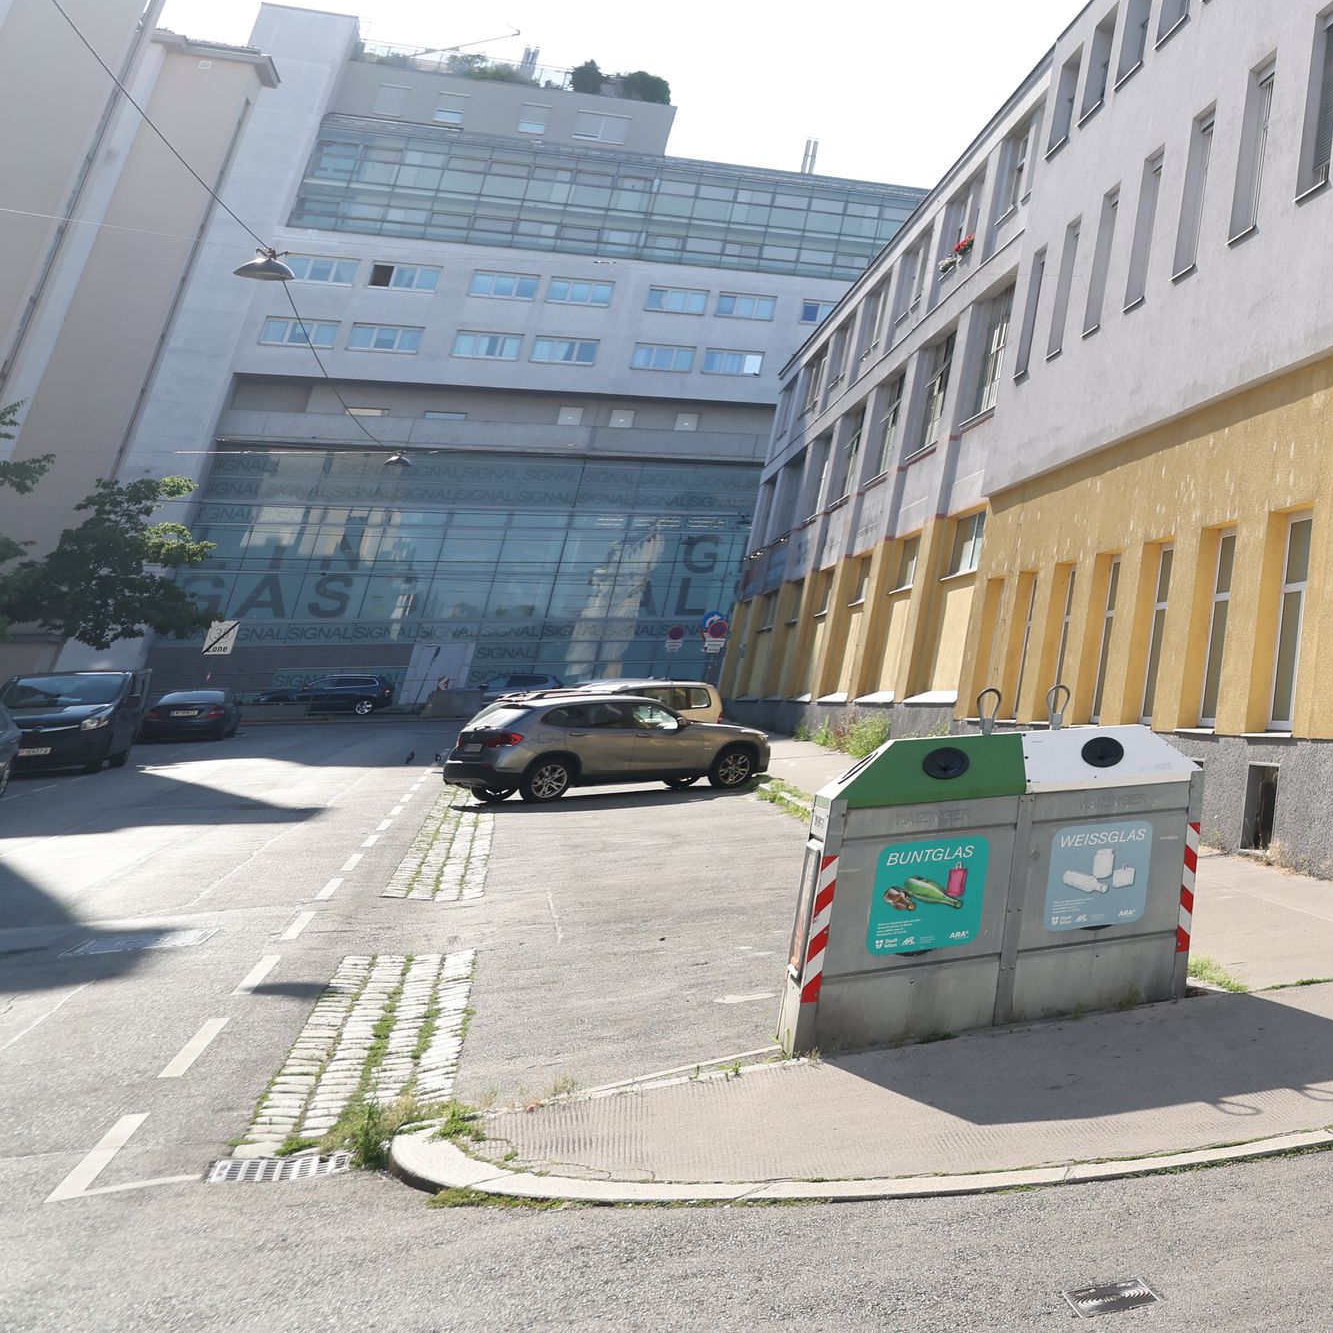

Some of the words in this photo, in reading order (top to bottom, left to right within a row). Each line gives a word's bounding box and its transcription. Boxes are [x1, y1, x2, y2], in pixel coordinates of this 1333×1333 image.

[287, 626, 352, 640] SIGNAL
[475, 647, 534, 659] SIGNAL
[1060, 828, 1147, 848] WEISSGLAS
[886, 845, 975, 866] BUNTGLAS
